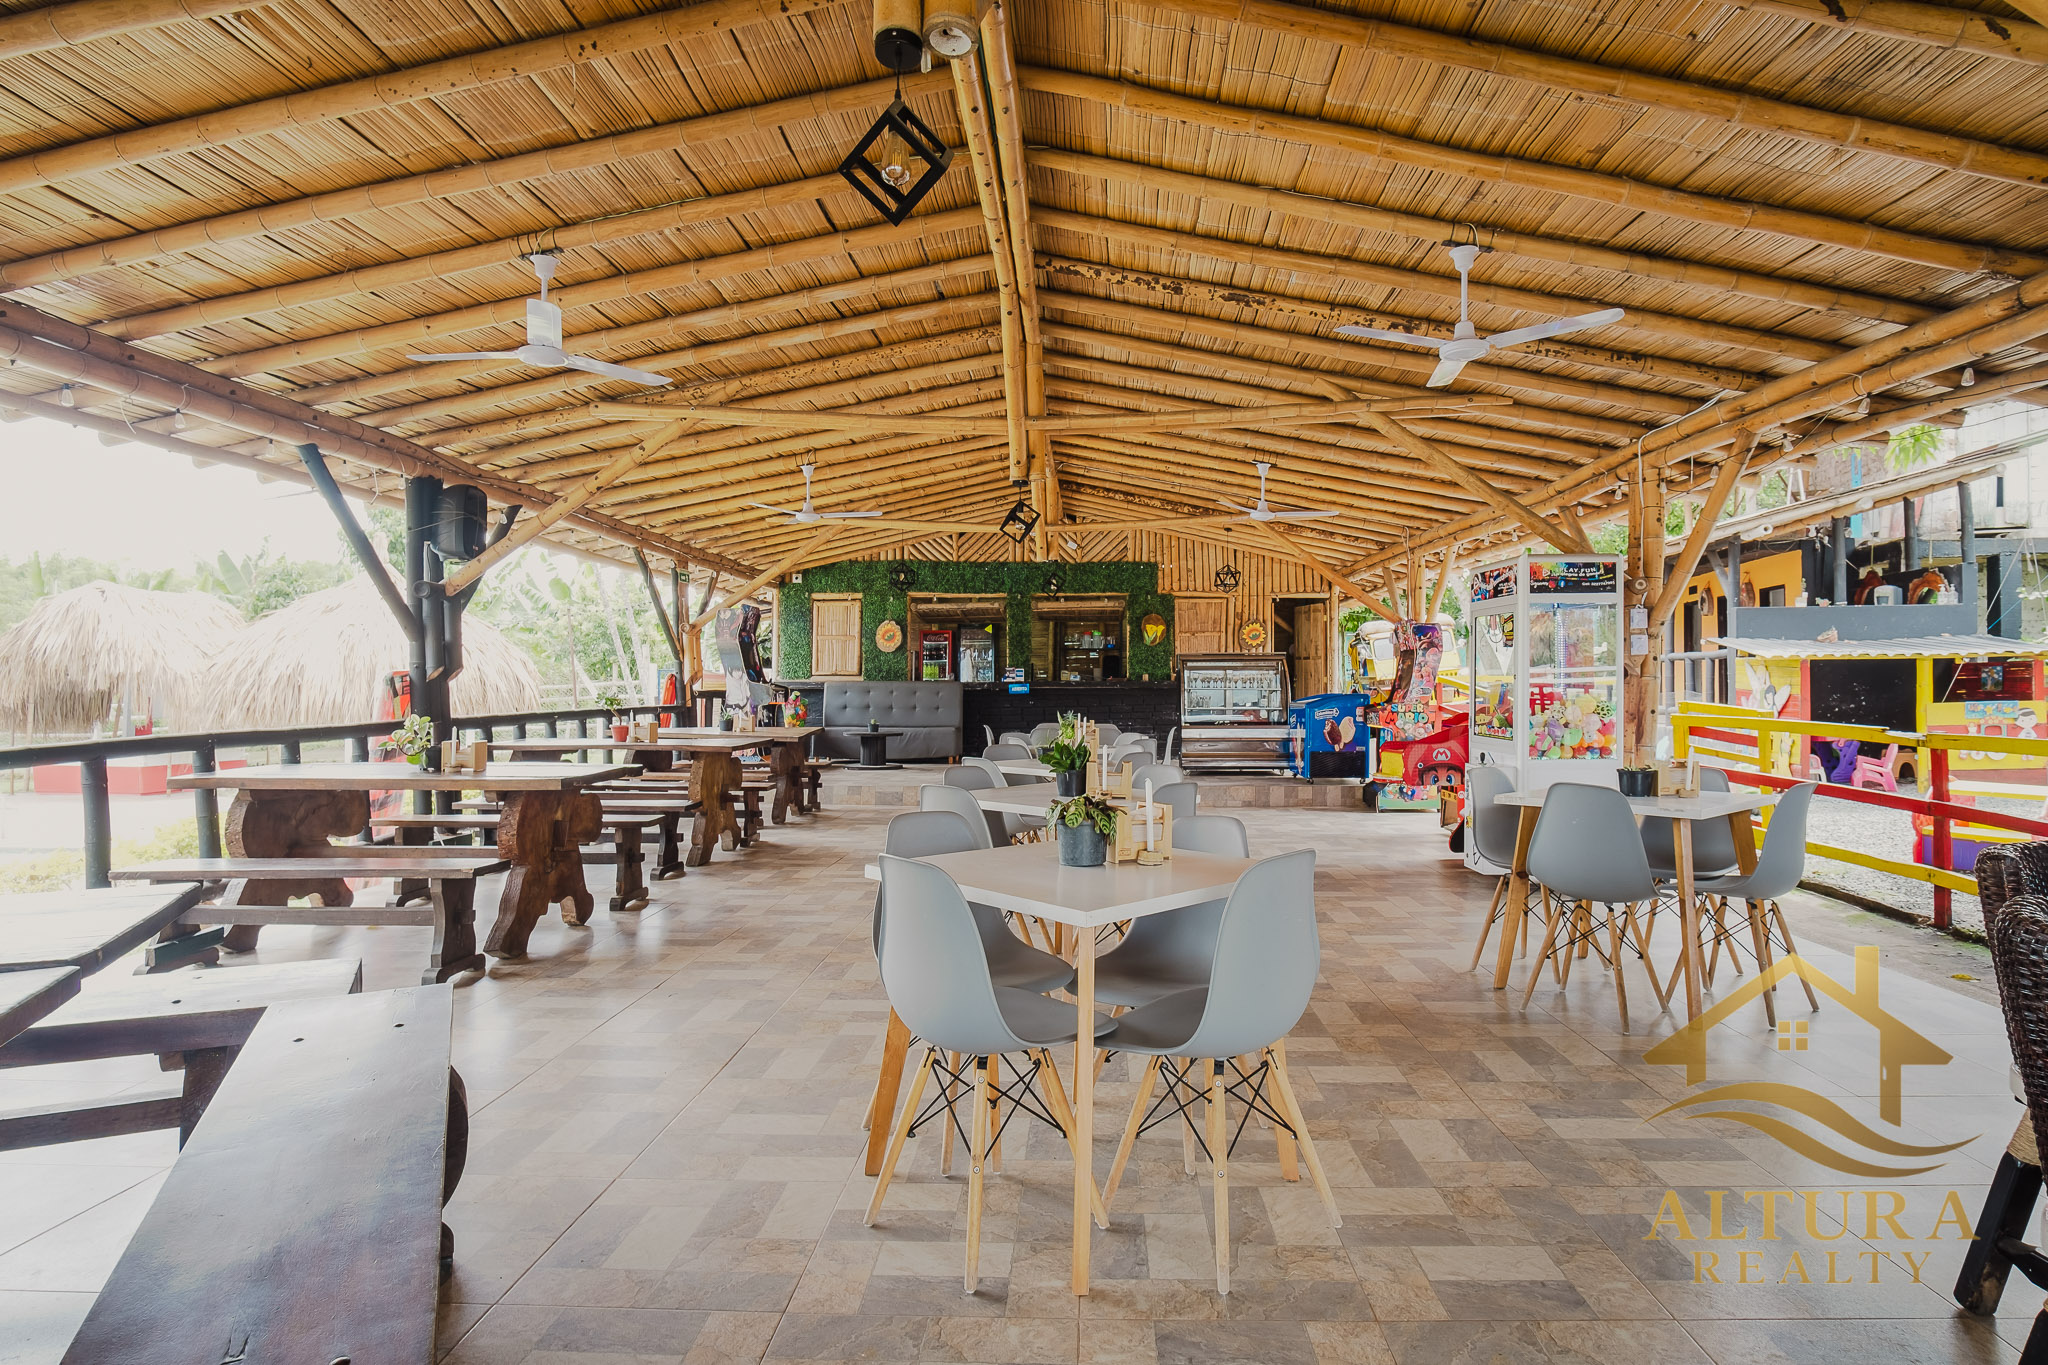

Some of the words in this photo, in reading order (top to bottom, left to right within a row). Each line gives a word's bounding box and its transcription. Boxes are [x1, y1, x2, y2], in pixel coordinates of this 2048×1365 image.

[1391, 704, 1424, 712] SUPER
[1385, 711, 1429, 724] MARIO
[1434, 749, 1449, 760] M
